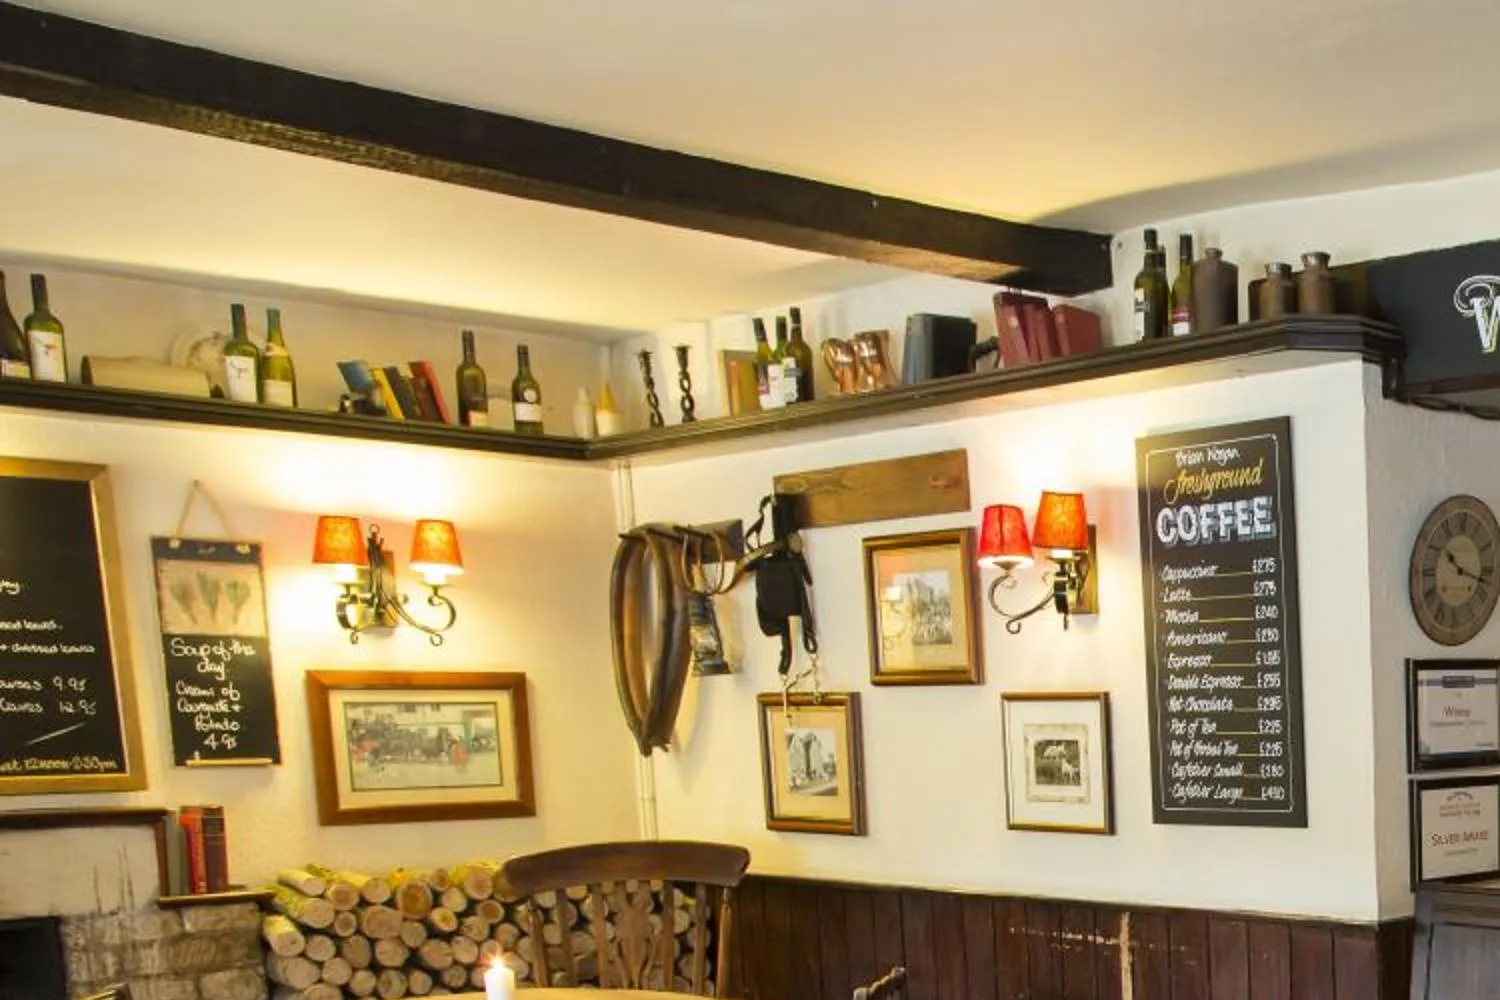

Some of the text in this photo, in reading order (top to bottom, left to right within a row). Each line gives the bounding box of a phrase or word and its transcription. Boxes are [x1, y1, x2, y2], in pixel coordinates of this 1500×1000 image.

[1156, 496, 1276, 547] COFFEE
[1165, 609, 1199, 624] Mocha
[1166, 628, 1228, 646] Americano
[170, 638, 257, 662] Soup of the
[1167, 653, 1212, 671] Espresso
[175, 680, 241, 701] Cream of
